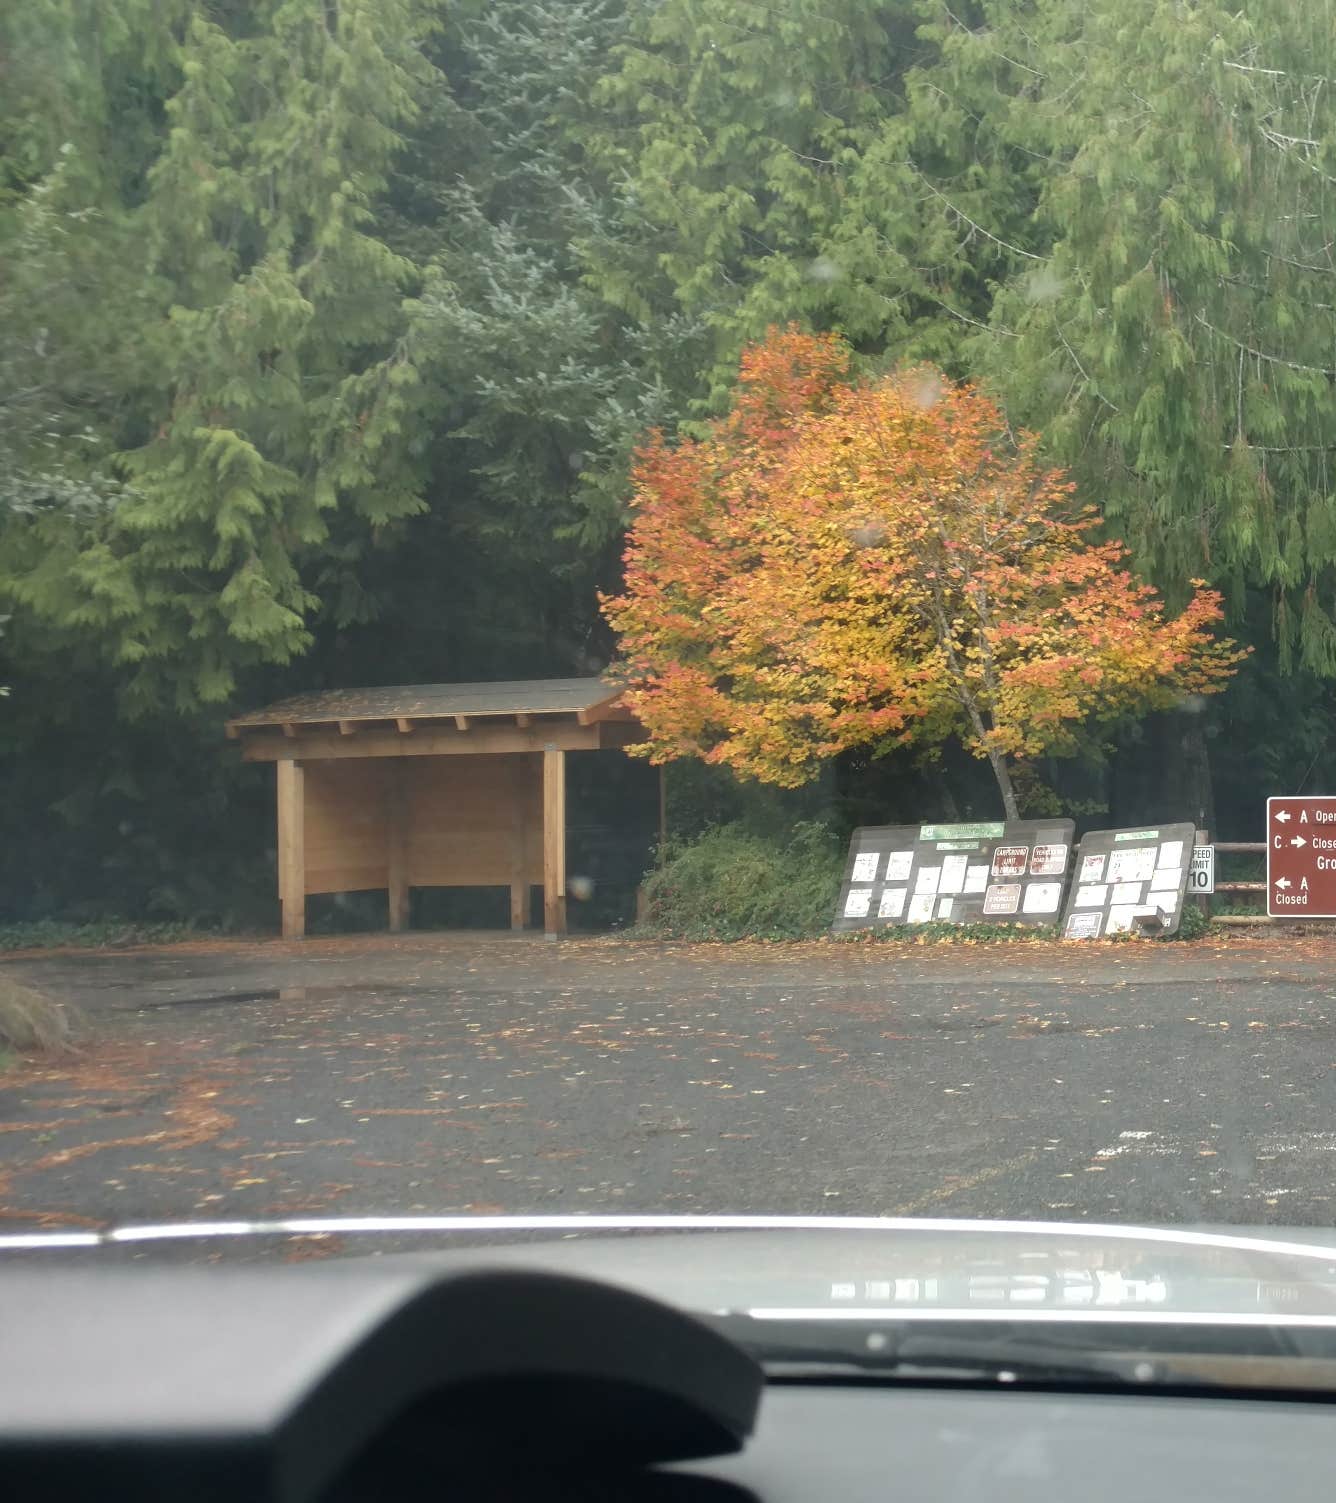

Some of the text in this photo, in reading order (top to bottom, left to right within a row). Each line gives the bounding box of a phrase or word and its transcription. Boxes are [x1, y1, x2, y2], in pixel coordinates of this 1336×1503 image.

[1300, 810, 1308, 823] A
[1274, 836, 1282, 849] C
[1192, 849, 1210, 859] PEED
[1189, 872, 1208, 887] 10
[1300, 877, 1308, 890] A
[1275, 893, 1308, 905] Closed
